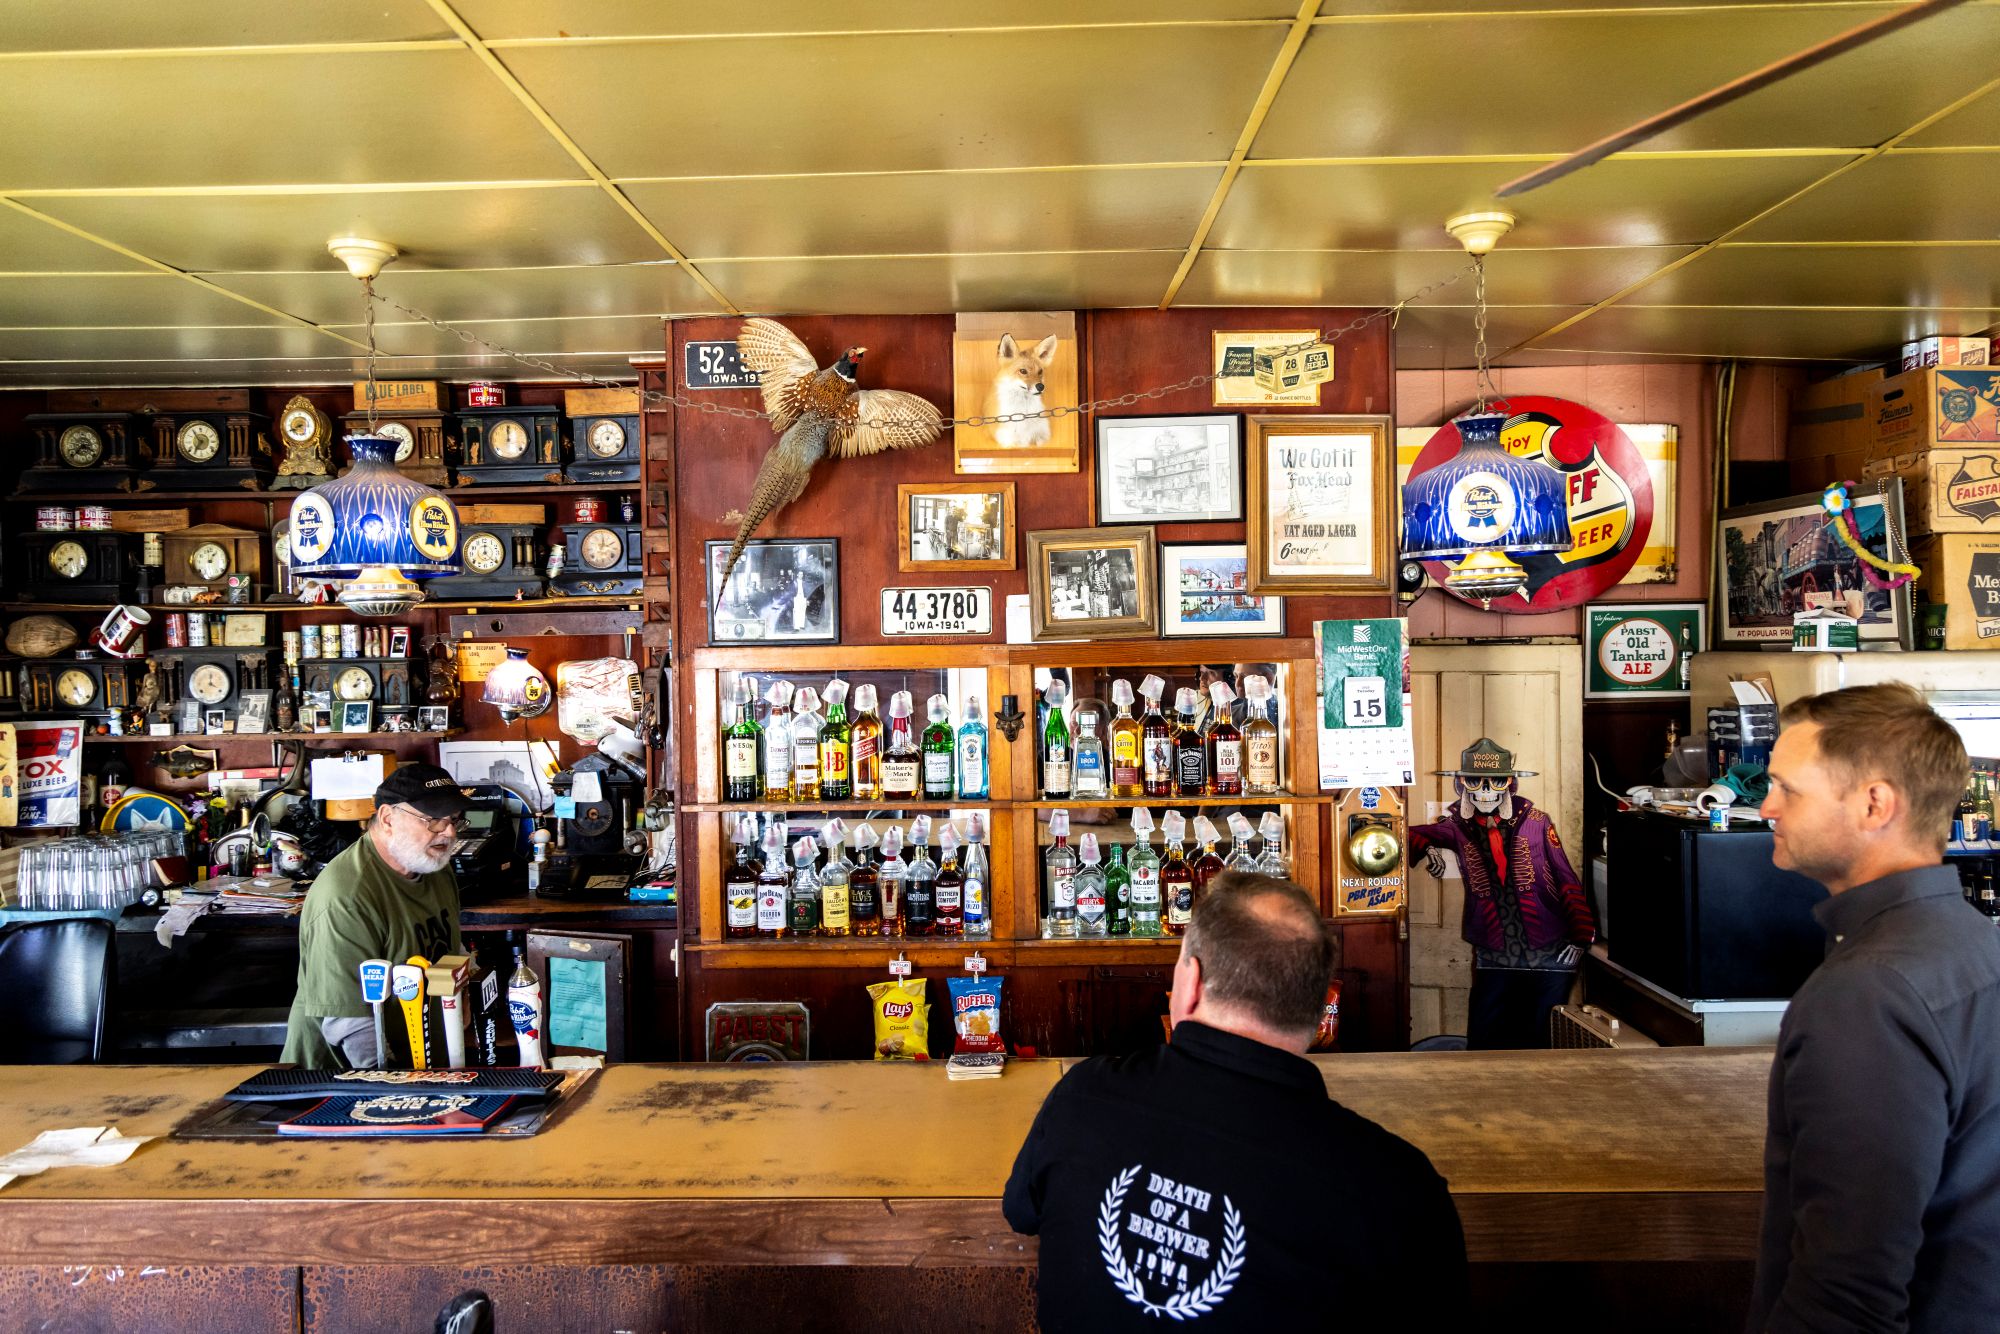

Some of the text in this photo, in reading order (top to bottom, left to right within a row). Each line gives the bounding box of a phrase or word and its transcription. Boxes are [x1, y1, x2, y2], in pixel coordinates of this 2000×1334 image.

[700, 346, 725, 374] 52
[1286, 358, 1297, 370] 28
[1307, 360, 1328, 369] HEAD
[1309, 354, 1324, 362] FOX
[366, 383, 426, 400] BLUE LABEL
[1882, 420, 1910, 435] BEER
[1280, 448, 1357, 468] We Got it
[1287, 471, 1353, 490] Fox Head
[1471, 490, 1495, 501] Pabst
[300, 510, 315, 520] Pabst
[426, 508, 444, 520] Pabst
[433, 522, 450, 530] Ribbon
[1284, 524, 1357, 538] VAT AGED LAGER
[892, 592, 978, 620] 44 3780
[905, 620, 965, 630] IOWA-1941
[1620, 628, 1658, 636] PABST
[1748, 630, 1778, 638] POPULAR
[1338, 644, 1388, 654] MidWestOne
[1626, 637, 1650, 648] Old
[1610, 648, 1666, 662] Tankard
[1622, 662, 1652, 674] ALE
[1353, 698, 1382, 718] 15
[1251, 742, 1272, 750] Tito's
[1220, 758, 1236, 766] 101
[1473, 752, 1500, 761] VOODOO
[1473, 760, 1500, 769] RANGER
[22, 776, 67, 790] LUXE BEER
[20, 811, 42, 820] CANS
[1342, 878, 1400, 887] NEXT ROUND
[730, 888, 740, 896] OLD
[760, 890, 782, 900] JIM BEAM
[1346, 886, 1382, 902] PBR me
[1367, 890, 1396, 908] ASAP!
[402, 983, 418, 992] MOON
[482, 978, 498, 1006] IPA
[885, 1002, 912, 1018] Lay's
[956, 994, 995, 1012] RUFFLES
[716, 1014, 804, 1054] PABST
[354, 1096, 428, 1110] Ribbon
[1147, 1172, 1212, 1212] DEATH
[1150, 1199, 1190, 1230] OF A
[1127, 1213, 1210, 1260] BREWER
[1156, 1245, 1174, 1259] AN
[1136, 1248, 1188, 1282] IOWA
[1134, 1264, 1188, 1292] FILM
